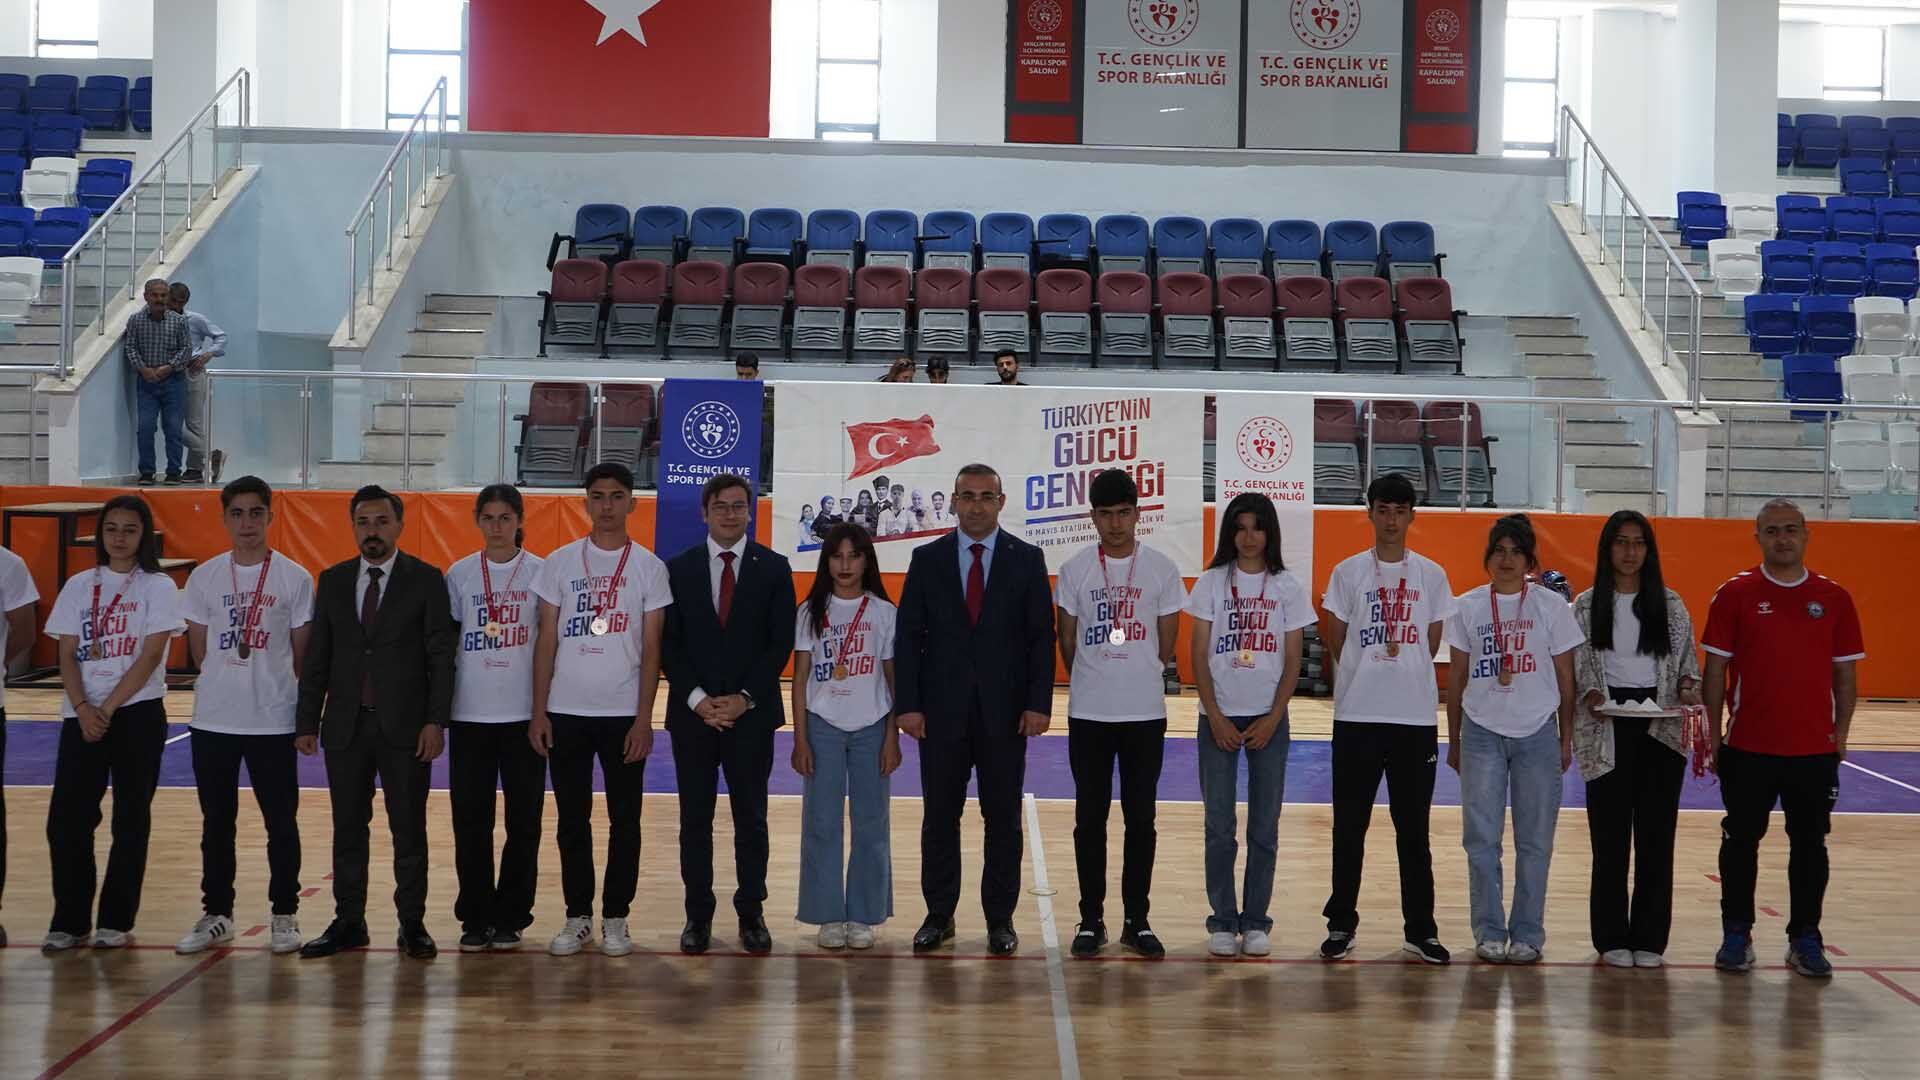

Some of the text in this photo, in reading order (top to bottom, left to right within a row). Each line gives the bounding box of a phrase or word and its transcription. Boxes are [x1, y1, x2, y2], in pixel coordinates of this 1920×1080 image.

[1097, 52, 1226, 69] T.C. GENÇLİK VE
[1260, 55, 1388, 73] T.C. GENÇLİK VE
[1097, 70, 1226, 85] SPOR BAKANLIĞI
[1260, 74, 1388, 89] SPOR BAKANLIĞI
[1041, 397, 1150, 430] TÜRKİYE'NİN
[1054, 426, 1137, 468] GÜCÜ
[667, 464, 751, 476] T.C. GENÇLİK VE
[667, 475, 693, 484] SPOR
[1224, 480, 1242, 488] T.C.
[1245, 480, 1289, 491] GENÇLİK
